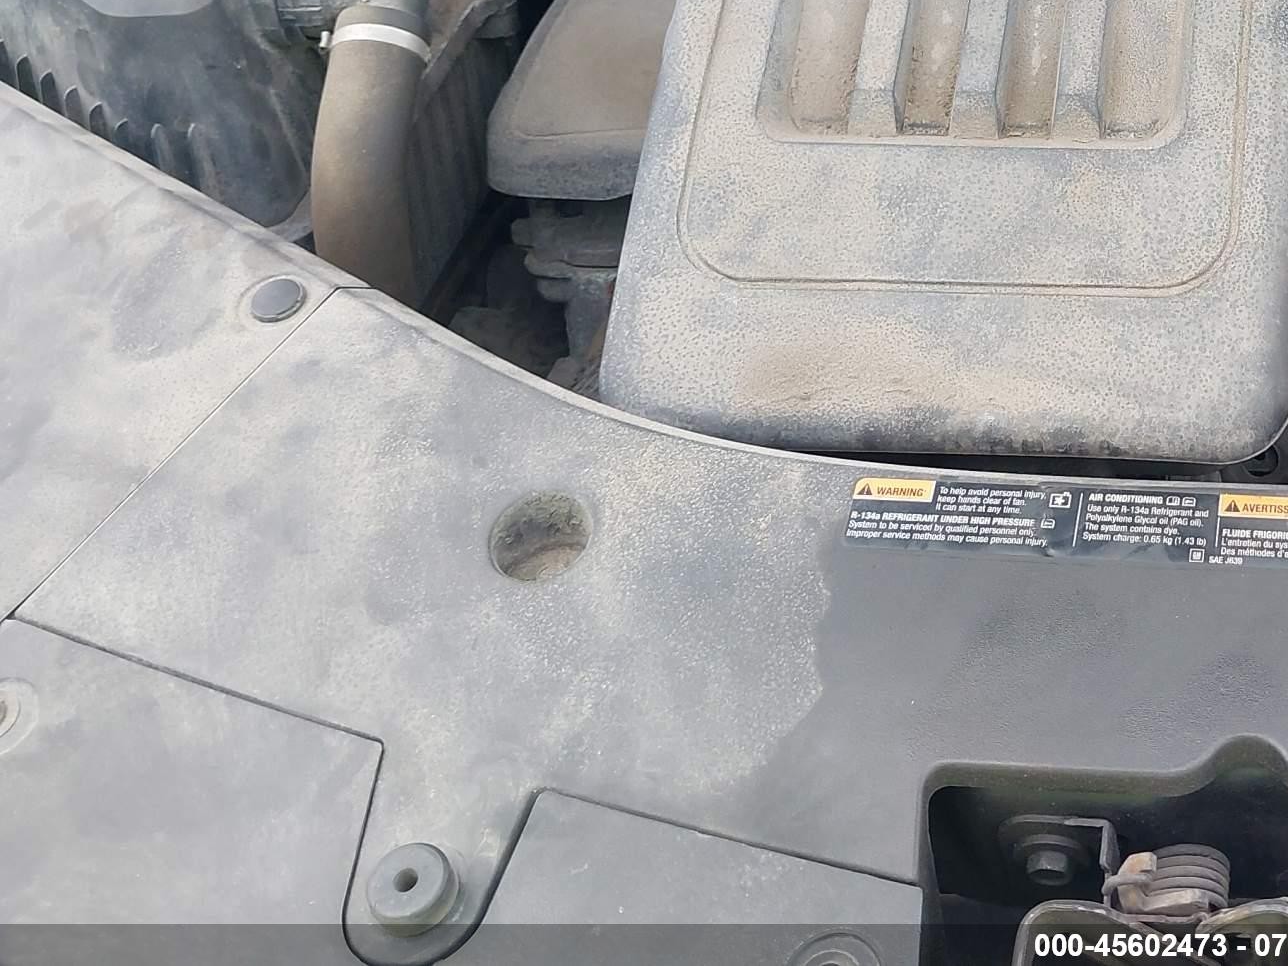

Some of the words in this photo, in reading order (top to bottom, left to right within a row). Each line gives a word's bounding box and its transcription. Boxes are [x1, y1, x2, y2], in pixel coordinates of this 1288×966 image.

[877, 486, 924, 497] WARNING
[950, 487, 966, 496] help
[968, 488, 990, 496] avoid
[989, 490, 1023, 498] personal
[937, 495, 956, 504] keep
[958, 496, 982, 504] hands
[982, 497, 1001, 505] clear
[1088, 493, 1103, 501] AIR
[1104, 494, 1164, 504] CONDITIONING
[986, 506, 1002, 514] any
[1087, 504, 1102, 512] Use
[1103, 505, 1120, 515] only
[1120, 506, 1149, 515] R-134a
[1150, 507, 1193, 517] Refrigerant
[1194, 509, 1209, 517] and
[850, 511, 881, 520] R-134a
[882, 512, 939, 522] REFRIGERANT
[940, 514, 968, 524] UNDER
[970, 516, 991, 525] HIGH
[991, 517, 1036, 527] PRESSURE
[1134, 515, 1158, 525] Glycol
[1158, 516, 1168, 524] oil
[848, 520, 877, 529] System
[900, 522, 932, 531] serviced
[945, 524, 979, 534] qualified
[979, 527, 1017, 536] personnel
[1085, 522, 1099, 530] The
[1100, 523, 1128, 533] system
[1129, 525, 1162, 534] contains
[1222, 528, 1252, 538] FLUIDE
[846, 529, 882, 539] Improper
[882, 531, 910, 539] service
[912, 532, 945, 541] methods
[947, 534, 964, 543] may
[965, 535, 989, 543] cause
[990, 536, 1023, 545] personal
[1082, 531, 1111, 541] System
[1143, 535, 1161, 544] 0.65
[1220, 547, 1236, 556] Des
